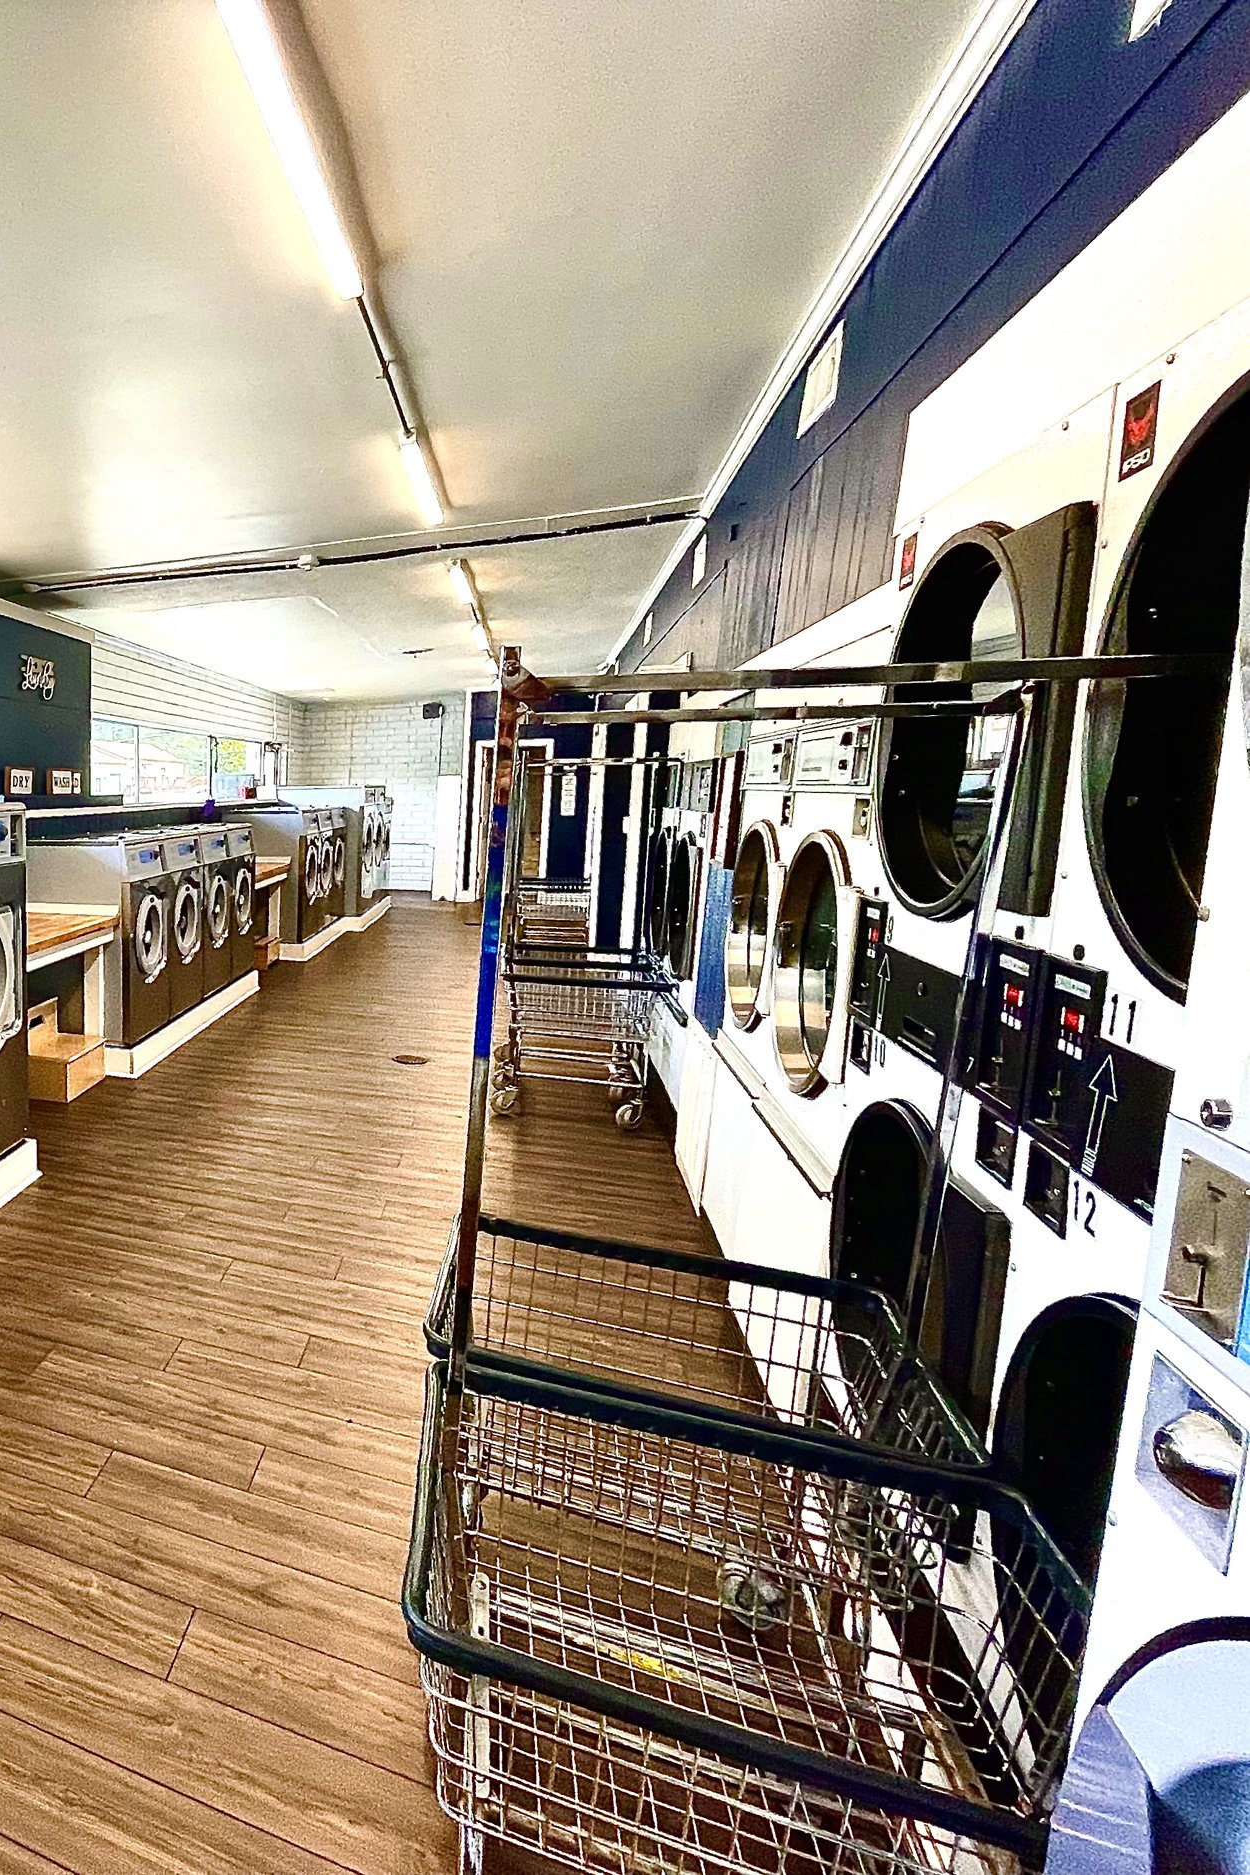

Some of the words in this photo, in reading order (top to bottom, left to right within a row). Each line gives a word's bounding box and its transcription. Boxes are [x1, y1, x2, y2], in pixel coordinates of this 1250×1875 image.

[12, 775, 30, 788] DRY
[53, 776, 70, 788] WASH
[886, 916, 894, 944] 9
[1108, 993, 1137, 1044] 11
[874, 1035, 886, 1068] 10
[1073, 1179, 1097, 1237] 12
